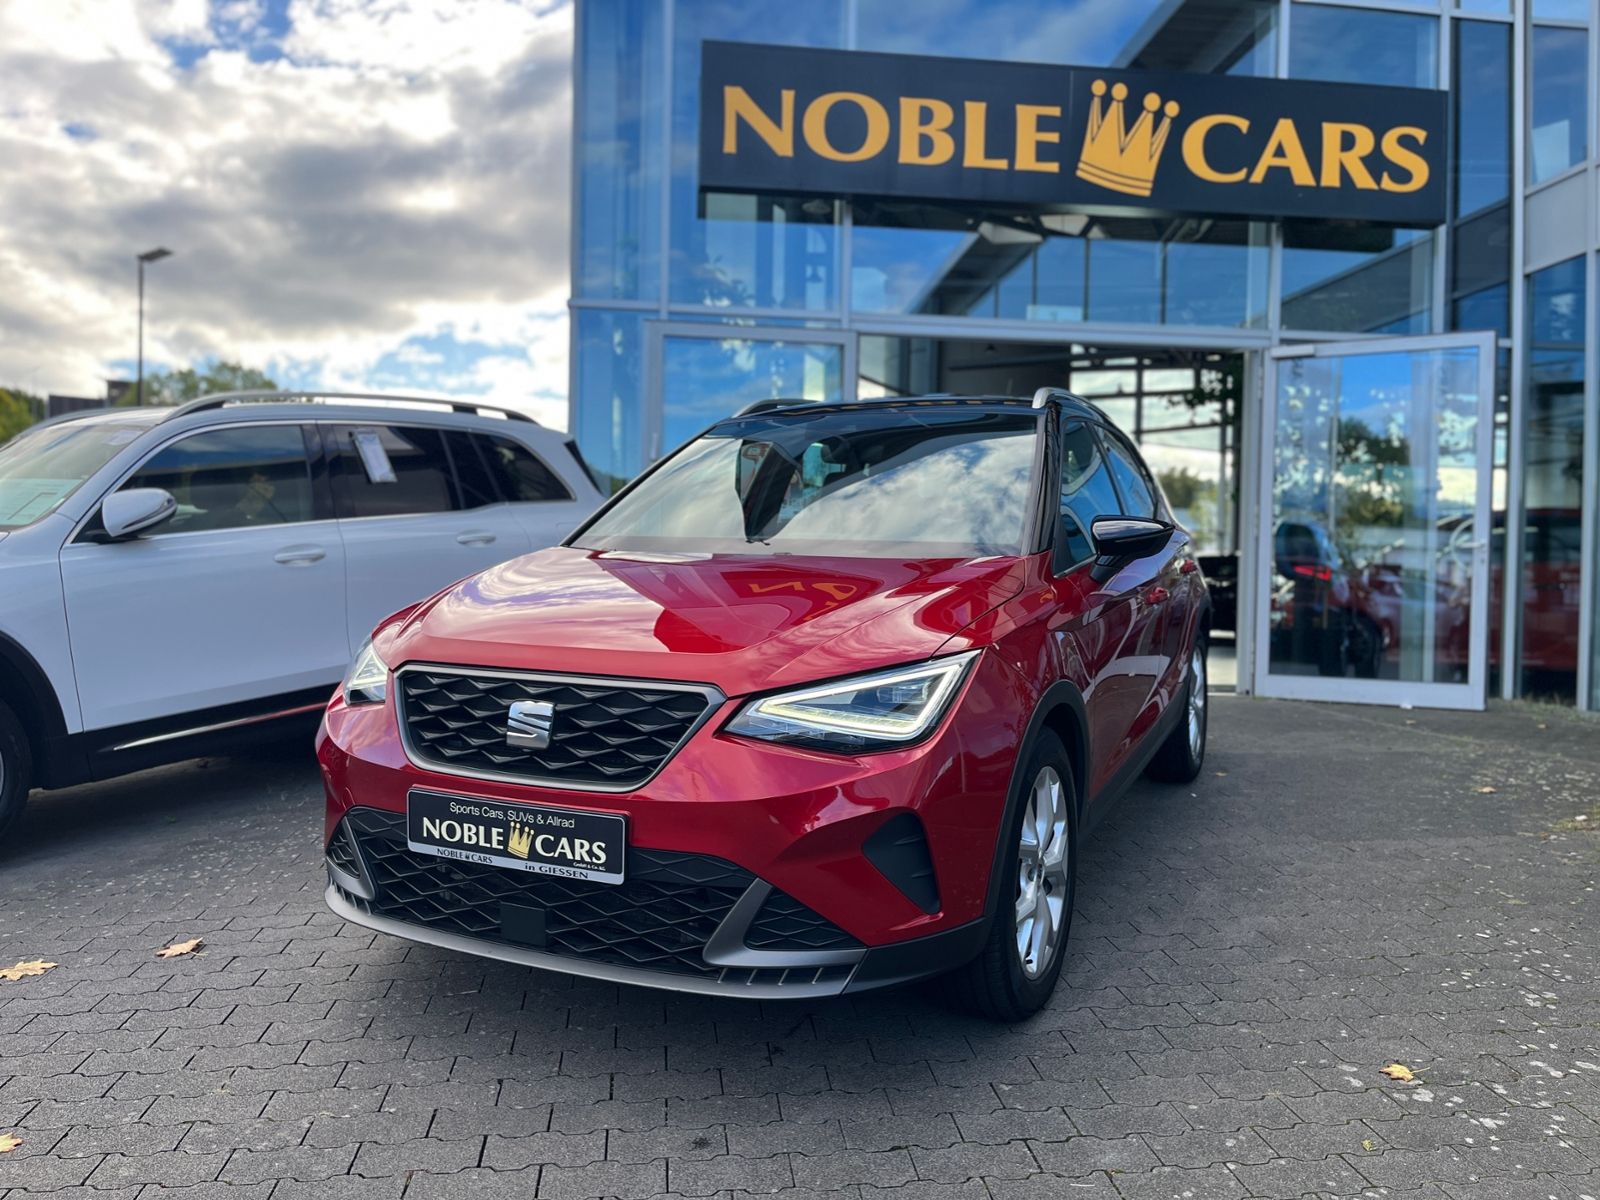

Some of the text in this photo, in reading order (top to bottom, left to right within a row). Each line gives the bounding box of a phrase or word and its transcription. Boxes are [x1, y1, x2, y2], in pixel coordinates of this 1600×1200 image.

[722, 85, 1430, 193] NOBLE CARS
[449, 801, 575, 828] Sports Cars, SUVs & Allrad
[422, 816, 607, 864] NOBLE CARS
[436, 848, 493, 864] NOBLE CARS
[524, 862, 536, 872] in
[539, 866, 589, 879] GIESSEN
